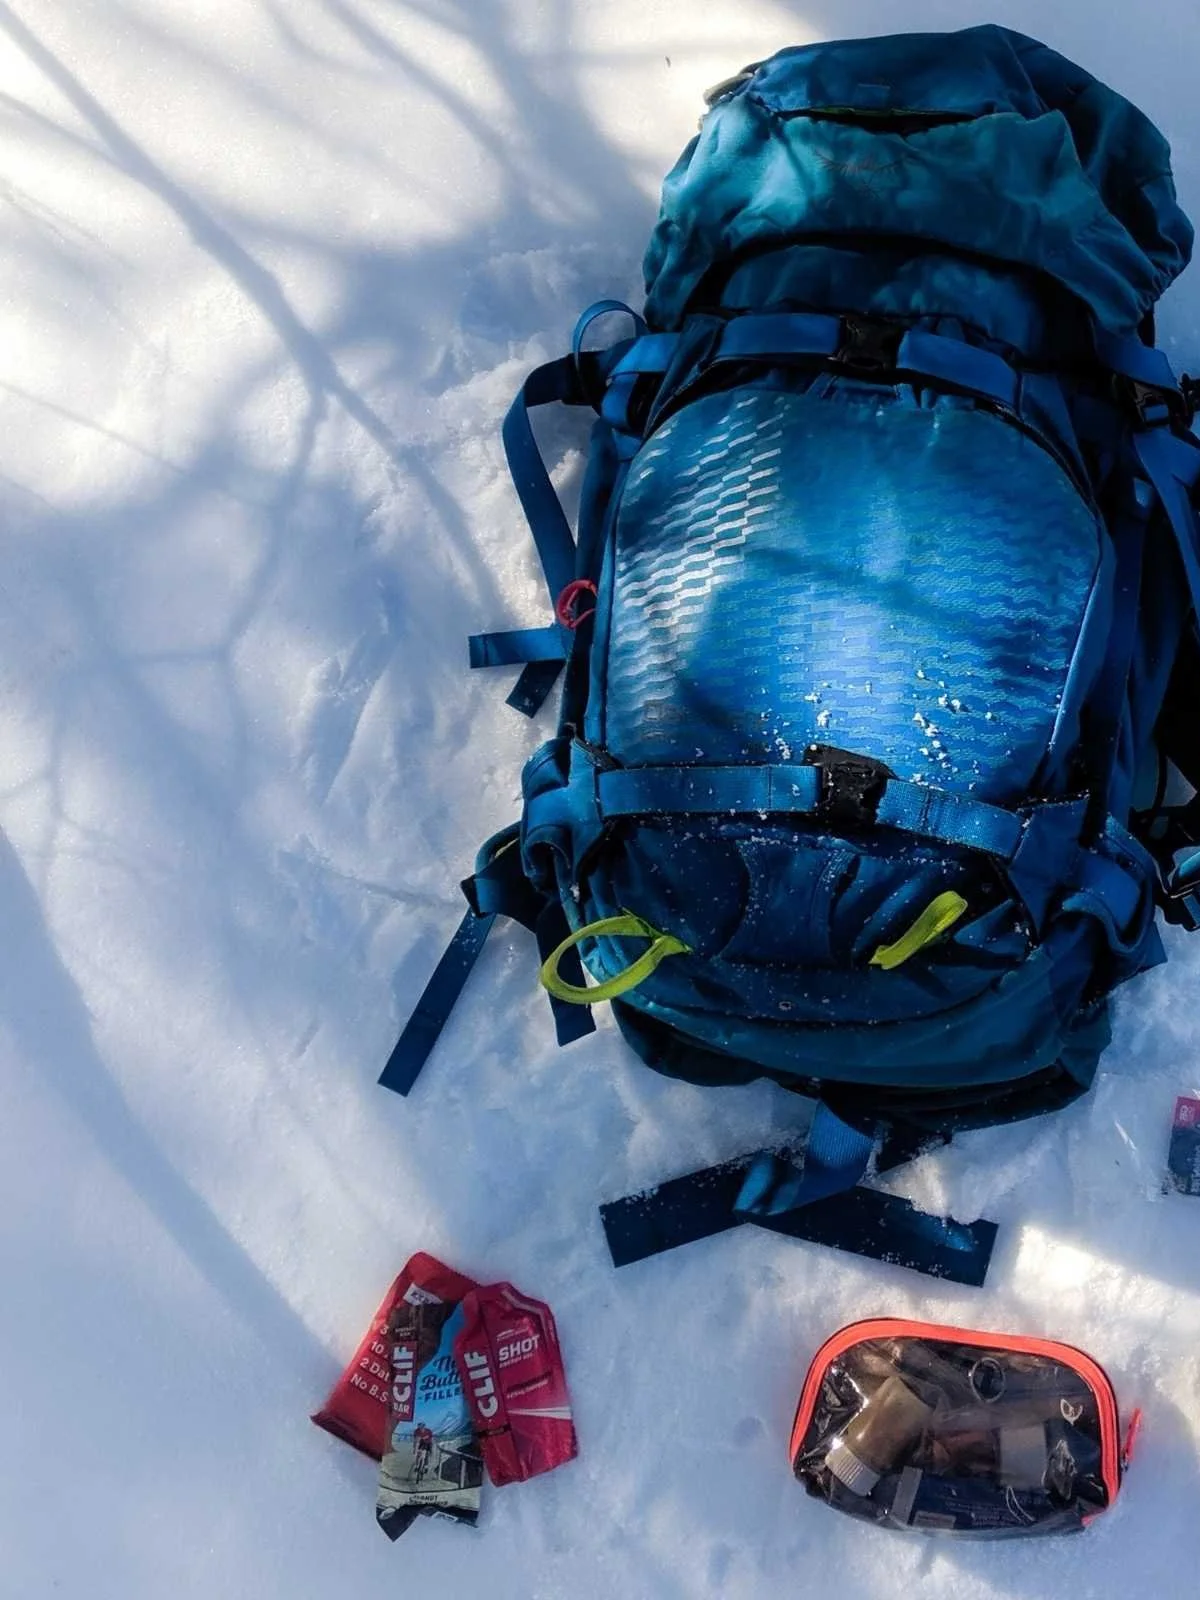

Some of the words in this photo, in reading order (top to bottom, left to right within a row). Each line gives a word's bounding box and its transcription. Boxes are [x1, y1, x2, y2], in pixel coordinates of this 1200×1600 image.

[499, 1334, 540, 1362] SHOT
[350, 1374, 368, 1390] No
[360, 1358, 370, 1369] 2
[369, 1361, 390, 1382] Dat
[392, 1346, 414, 1402] CLIF
[424, 1387, 461, 1402] FILLE
[463, 1351, 498, 1418] CLIF
[393, 1401, 410, 1414] BAR
